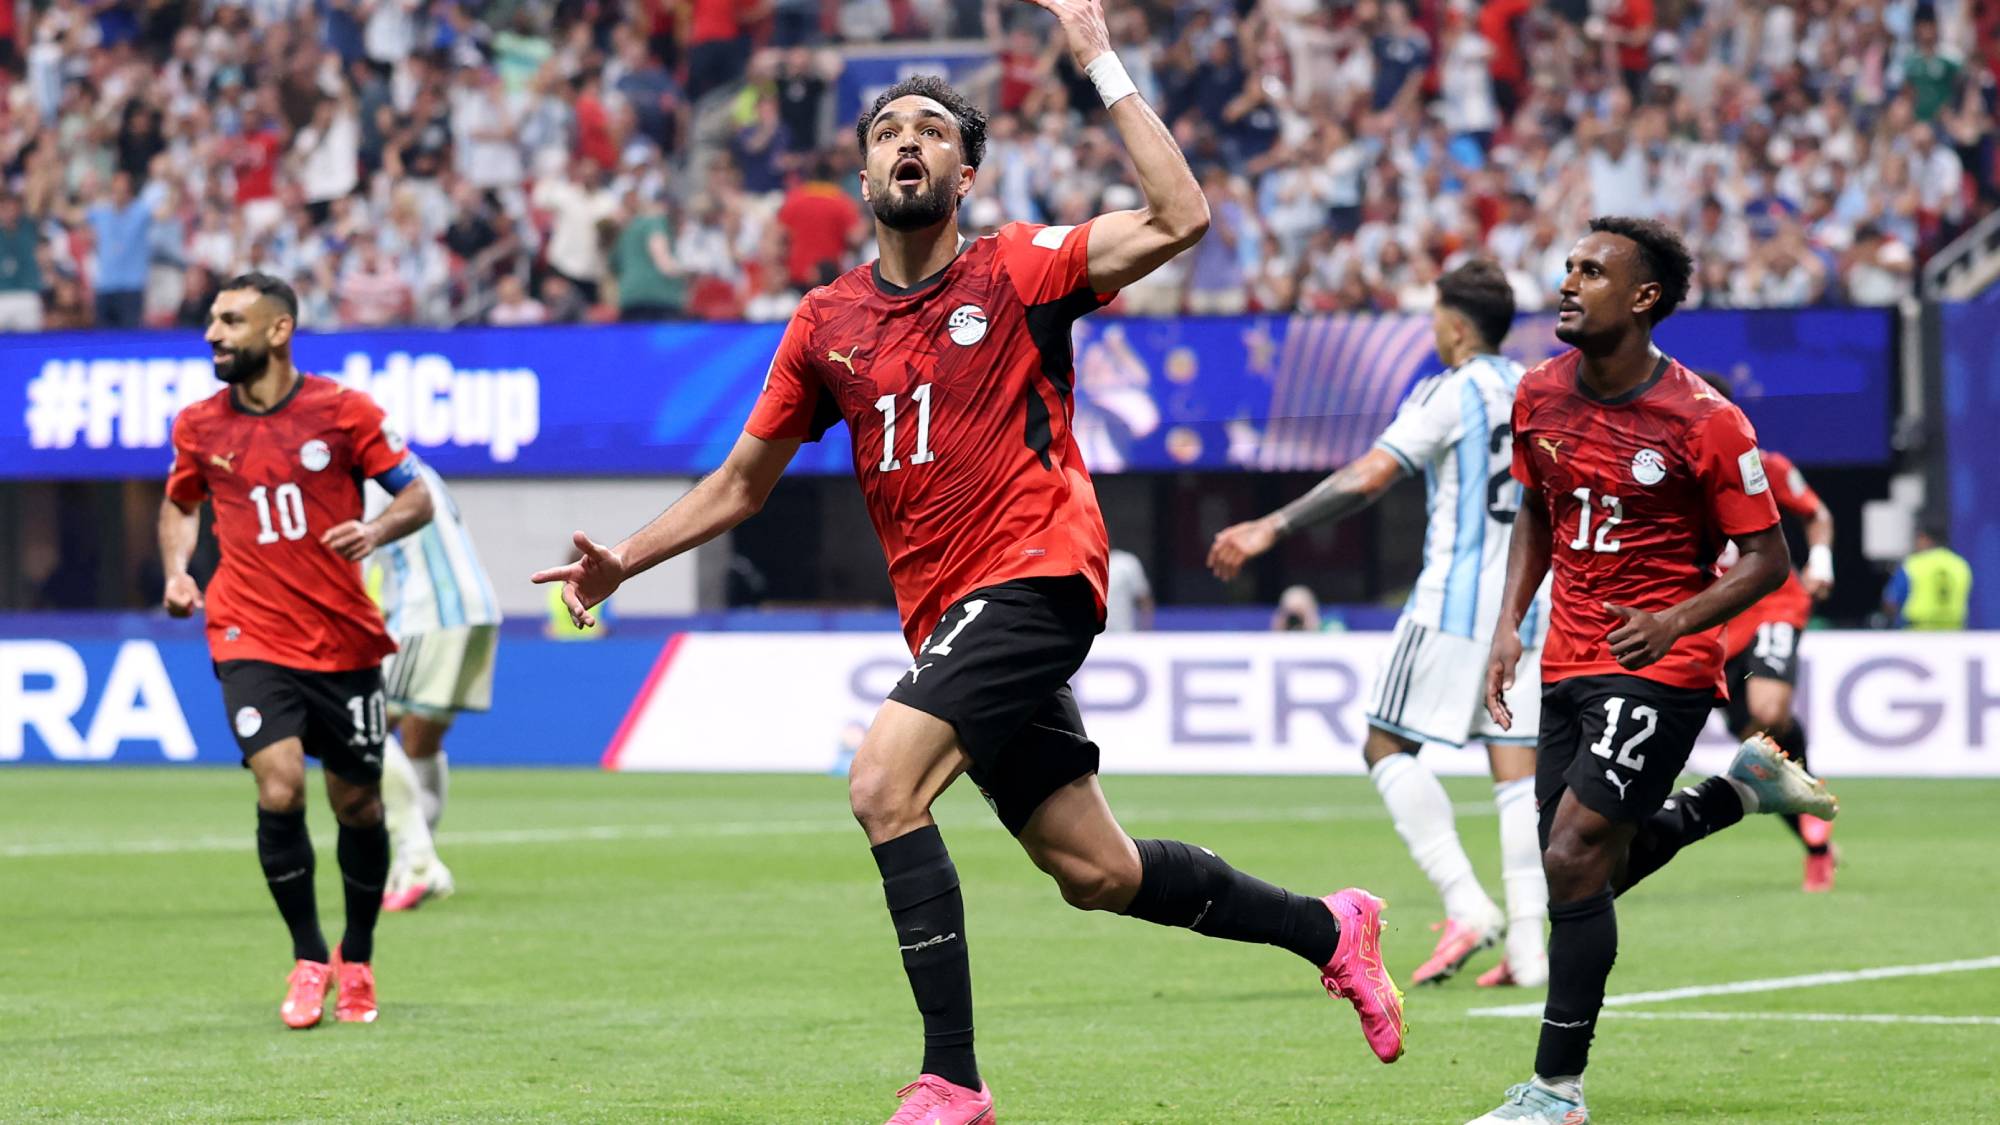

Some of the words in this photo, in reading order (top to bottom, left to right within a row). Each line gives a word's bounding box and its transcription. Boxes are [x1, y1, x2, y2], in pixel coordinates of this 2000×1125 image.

[875, 383, 934, 472] 11
[249, 482, 308, 545] 10
[1570, 487, 1622, 552] 12
[920, 599, 988, 656] 1
[0, 639, 198, 760] RA
[347, 690, 382, 746] 10
[849, 659, 1358, 745] PER
[1590, 697, 1658, 772] 12
